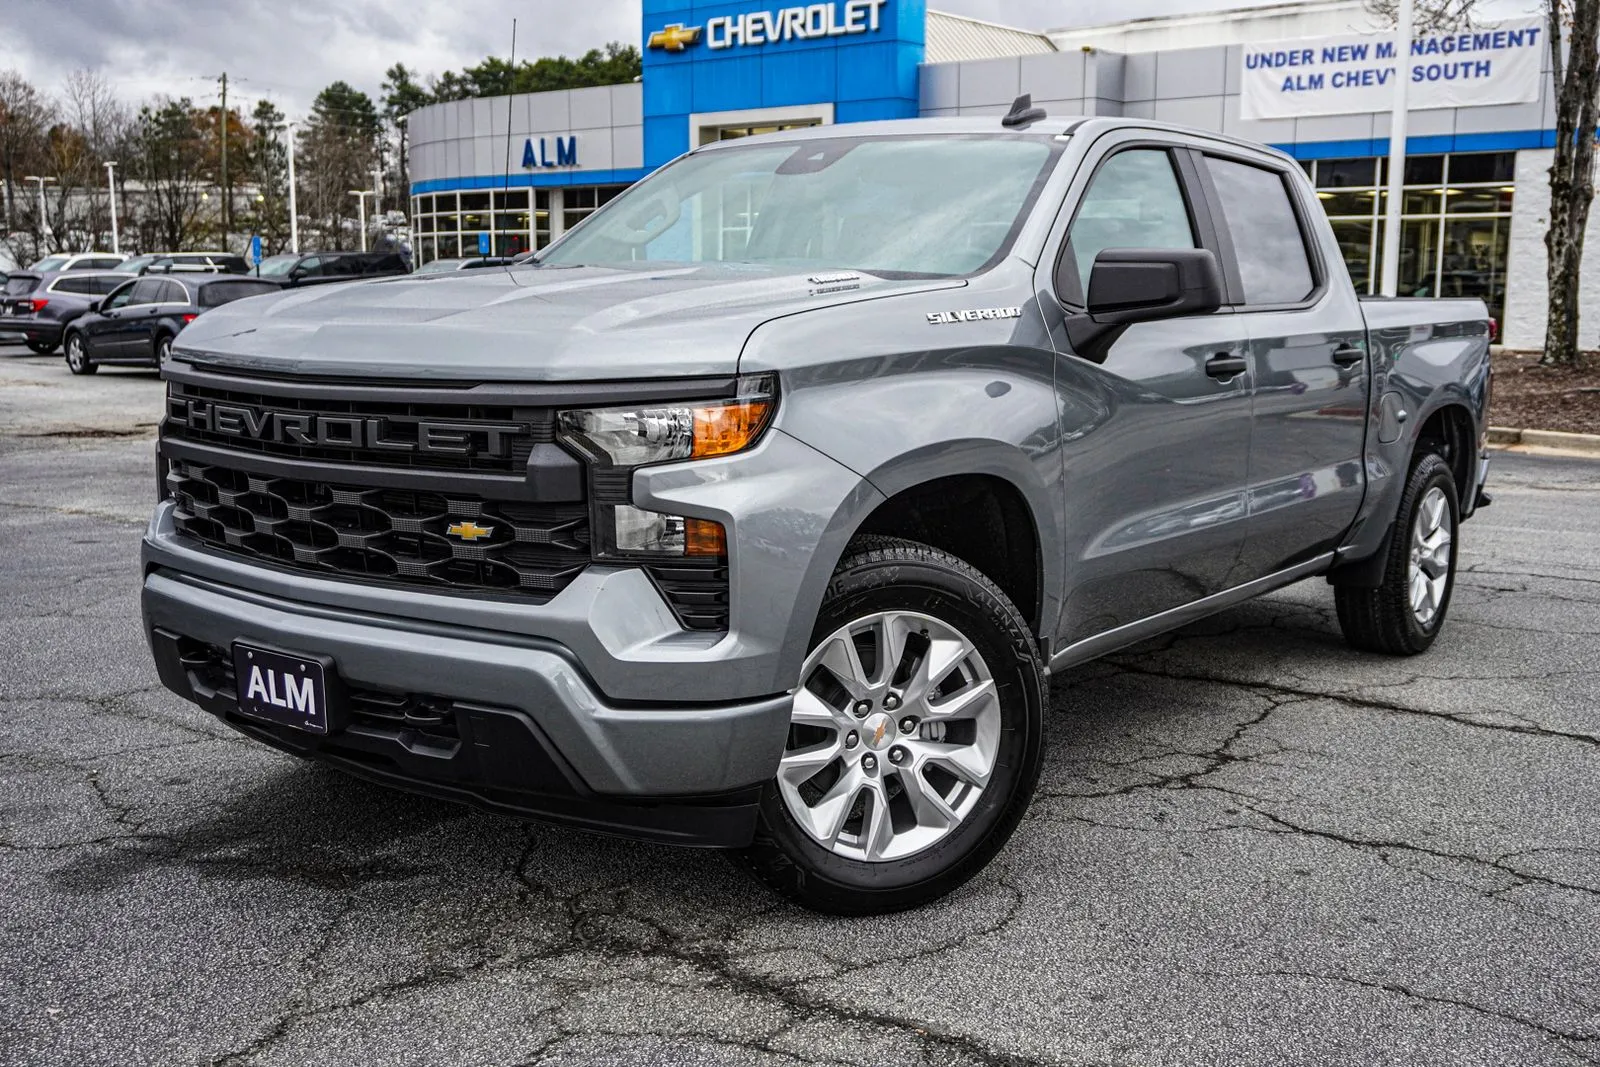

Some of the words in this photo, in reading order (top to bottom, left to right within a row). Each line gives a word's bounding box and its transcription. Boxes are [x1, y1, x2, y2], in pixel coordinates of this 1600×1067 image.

[707, 0, 886, 49] CHEVROLET
[1246, 50, 1313, 69] UNDER
[1321, 44, 1369, 63] NEW
[1376, 28, 1541, 59] MNAGEMENT
[1281, 72, 1324, 92] ALM
[1331, 67, 1396, 88] CHEV
[1412, 61, 1491, 82] SOUTH
[521, 136, 577, 168] ALM
[926, 306, 1021, 325] SILVERADO
[167, 396, 531, 457] CHEVROLET
[976, 591, 1025, 649] ALENZA
[247, 665, 316, 715] ALM
